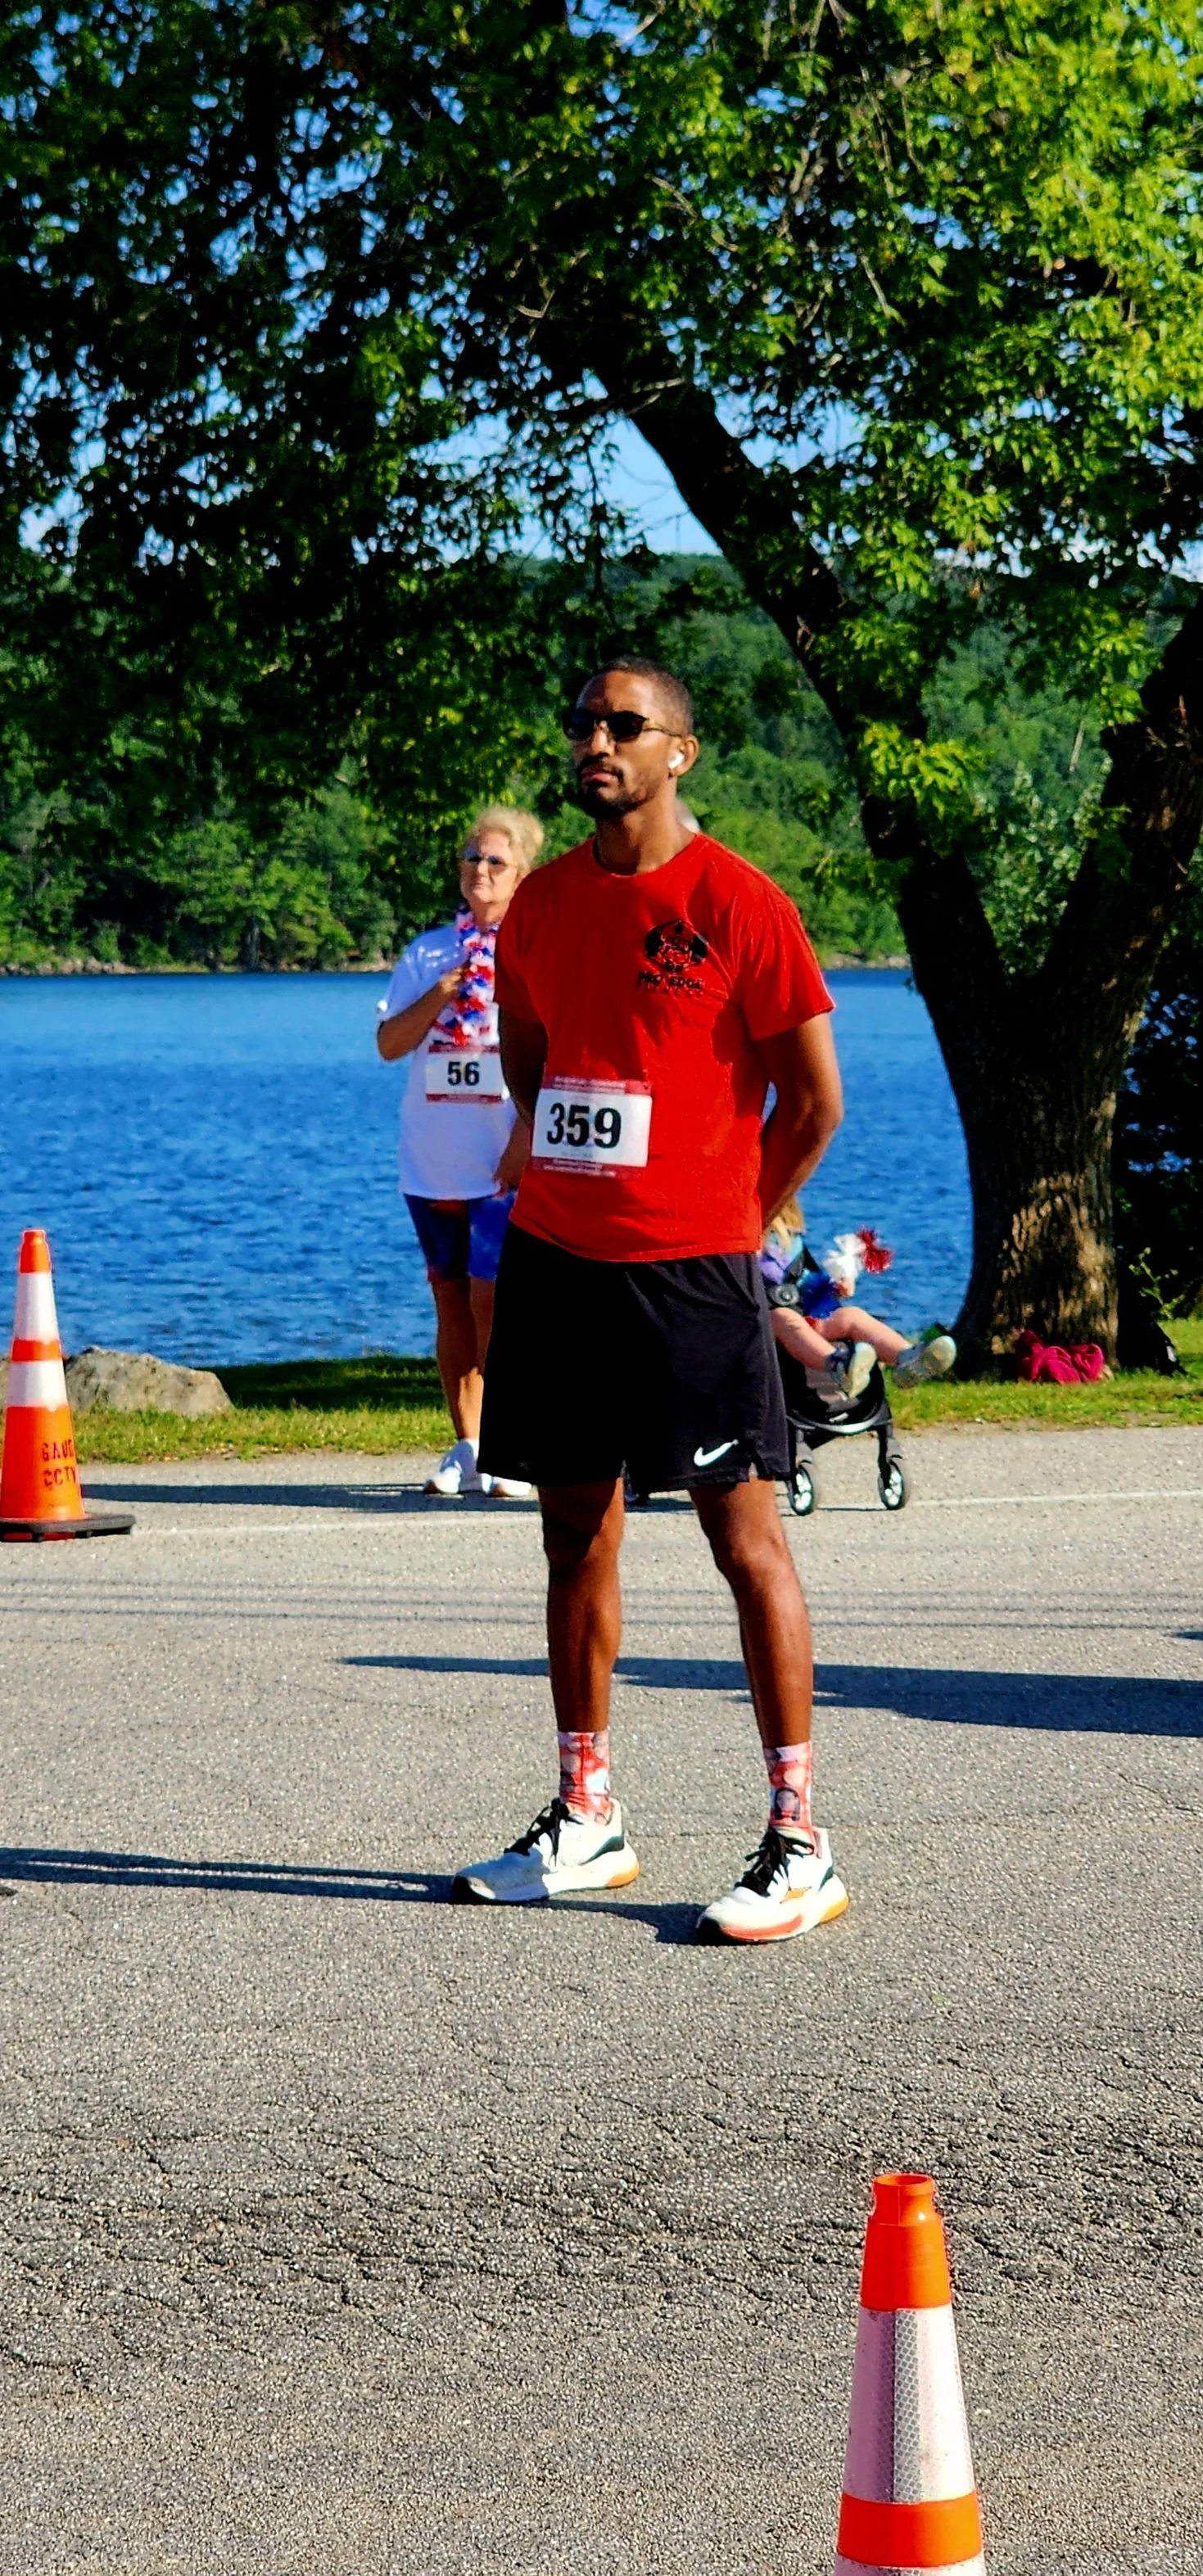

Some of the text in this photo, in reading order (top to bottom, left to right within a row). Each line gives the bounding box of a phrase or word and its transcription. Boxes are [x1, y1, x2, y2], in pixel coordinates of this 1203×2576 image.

[637, 970, 661, 986] PRO
[448, 1061, 480, 1086] 56
[547, 1103, 622, 1149] 359
